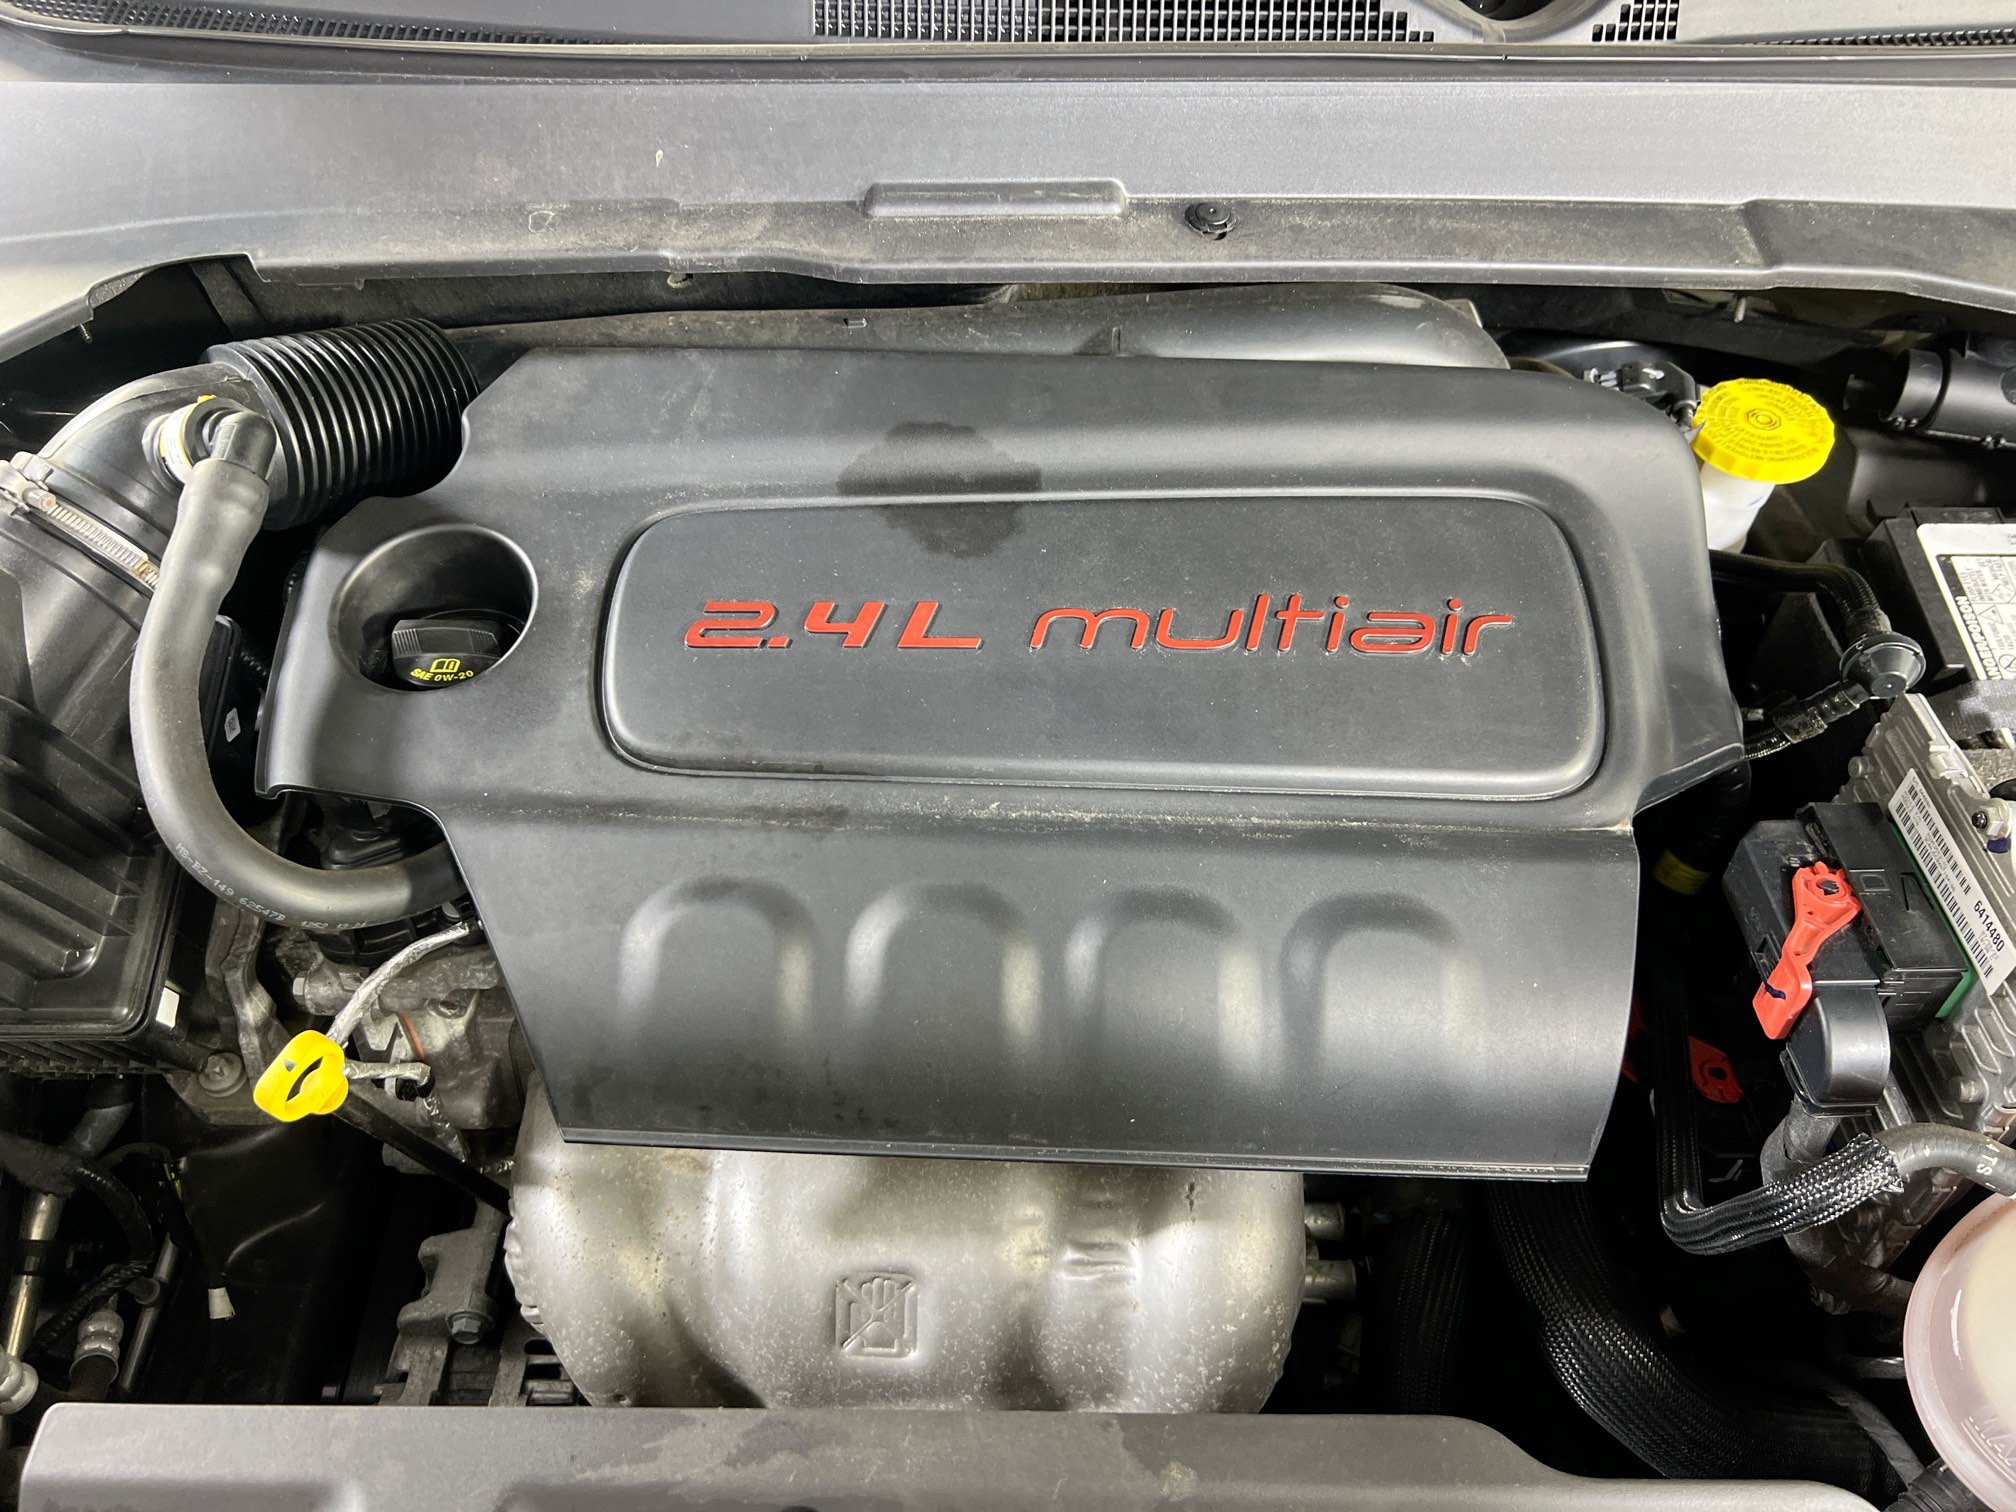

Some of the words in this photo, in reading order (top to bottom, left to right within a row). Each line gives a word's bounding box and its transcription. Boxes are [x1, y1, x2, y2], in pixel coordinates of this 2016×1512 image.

[1029, 594, 1514, 656] multiair
[410, 668, 434, 681] SAE
[434, 670, 474, 682] 0W-20
[1973, 900, 2005, 952] 6414480
